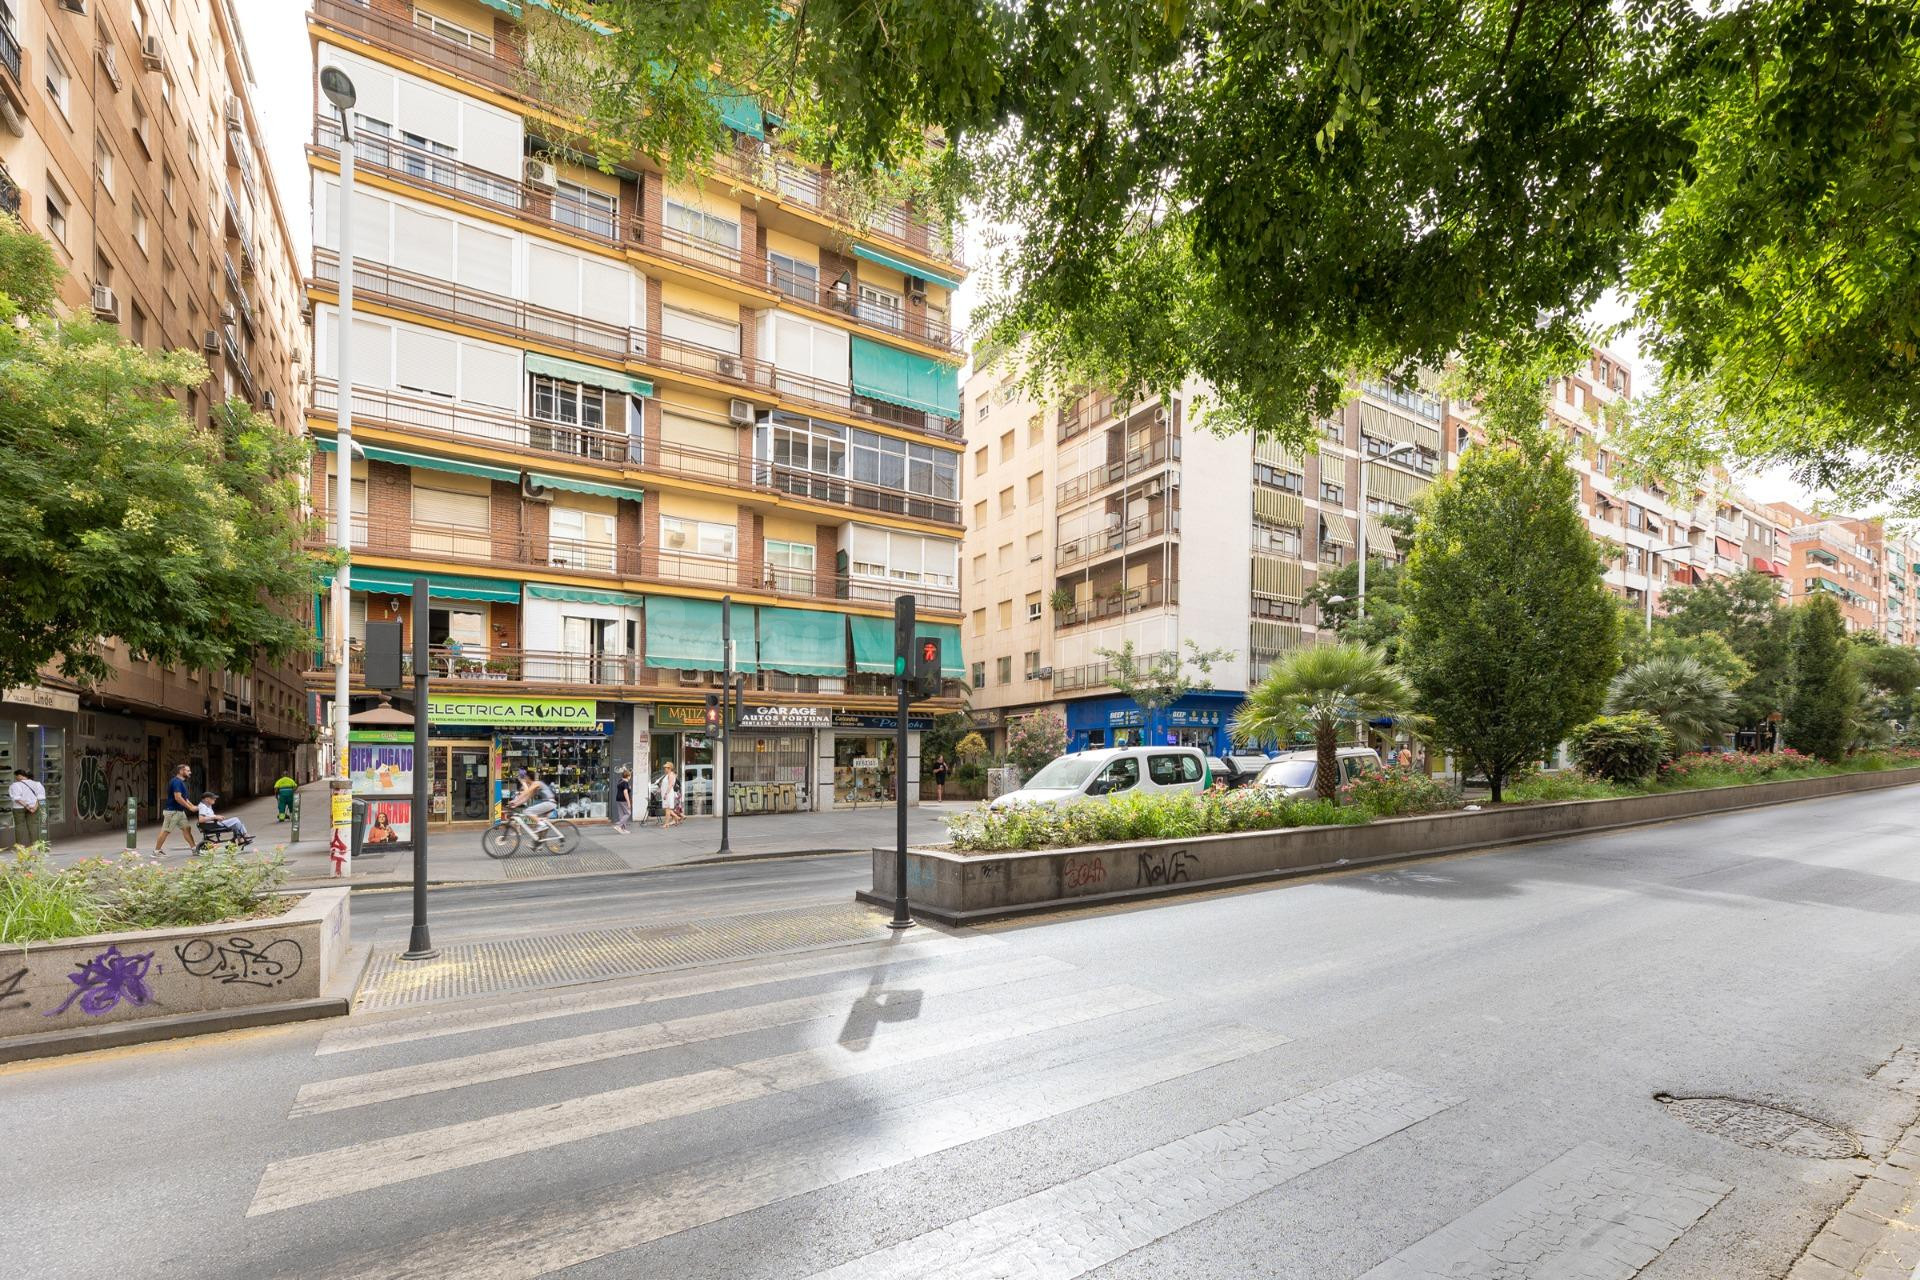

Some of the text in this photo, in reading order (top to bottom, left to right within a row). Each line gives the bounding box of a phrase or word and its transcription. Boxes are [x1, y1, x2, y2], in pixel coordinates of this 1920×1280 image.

[428, 703, 516, 717] ELECTRICA
[756, 706, 817, 716] GARAGE
[1110, 711, 1125, 719] BEEP
[350, 747, 413, 772] BIEN JUGADO
